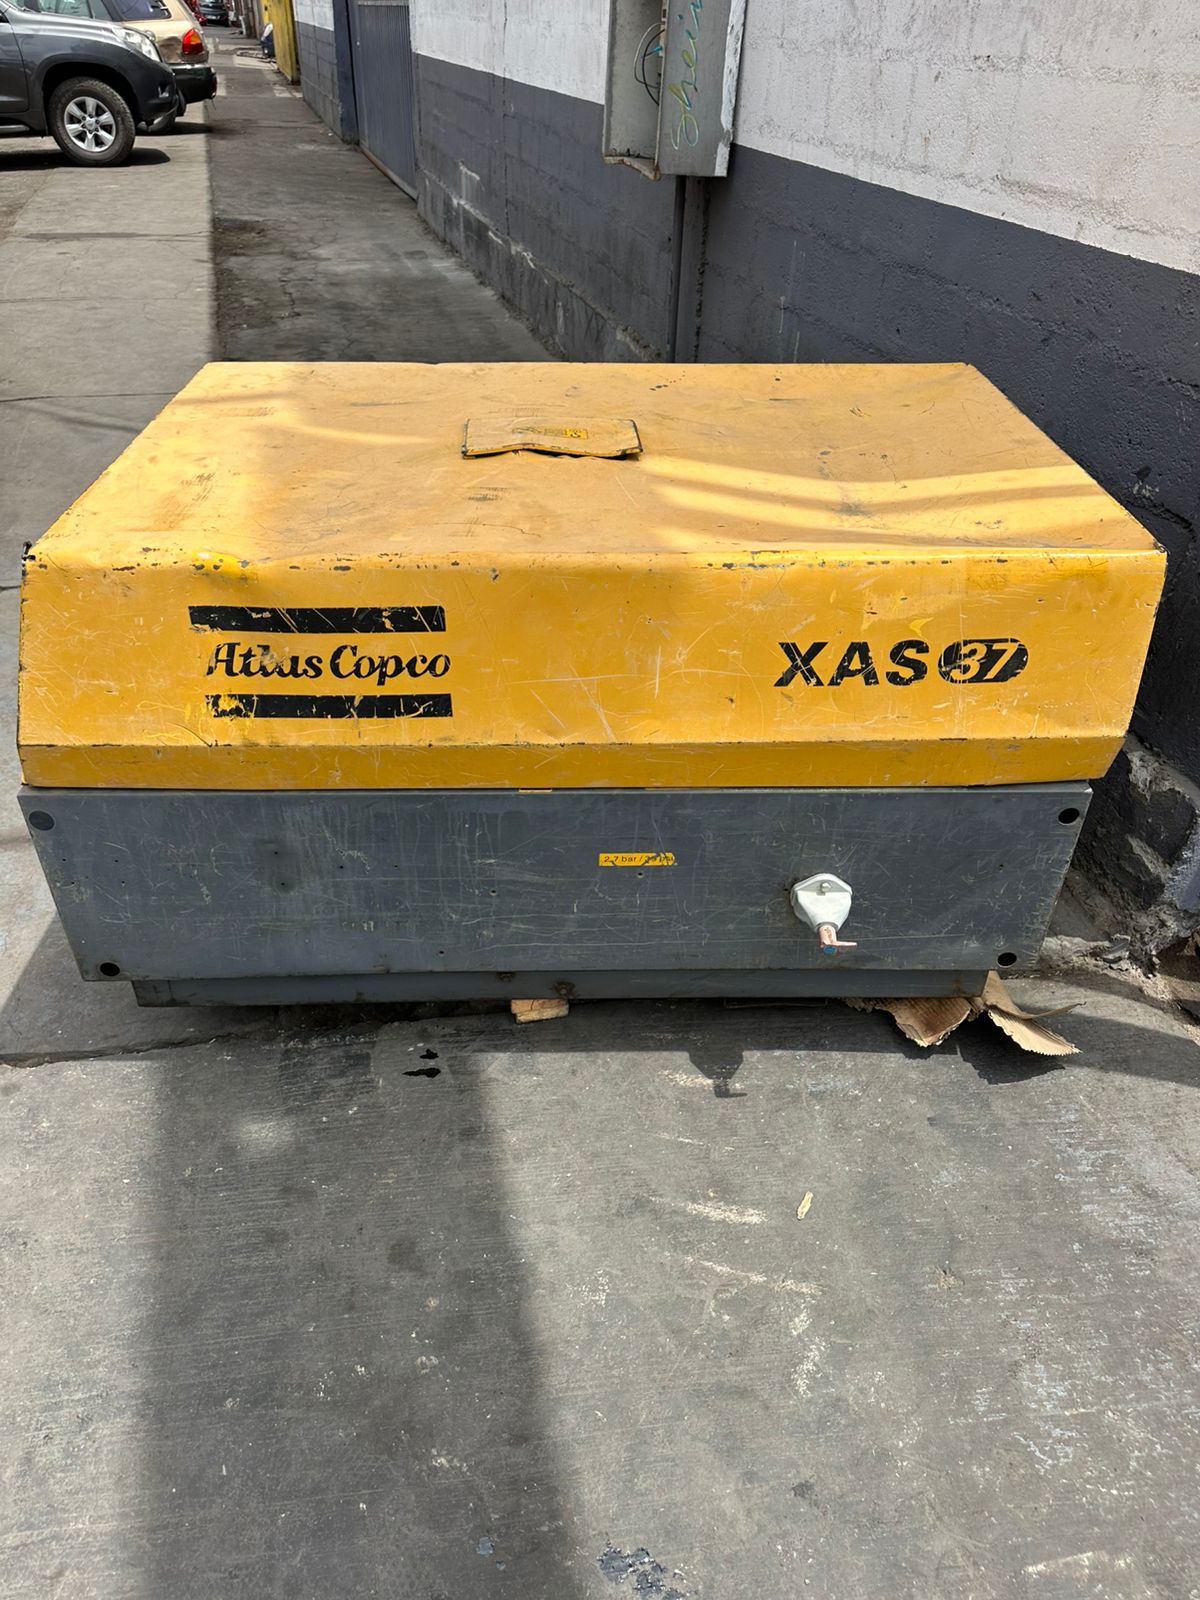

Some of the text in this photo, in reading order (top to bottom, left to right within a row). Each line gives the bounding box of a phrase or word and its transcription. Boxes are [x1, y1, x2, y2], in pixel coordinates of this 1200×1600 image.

[206, 642, 451, 686] Atlas Copco
[773, 639, 1019, 687] XAS 37
[621, 855, 637, 863] bar
